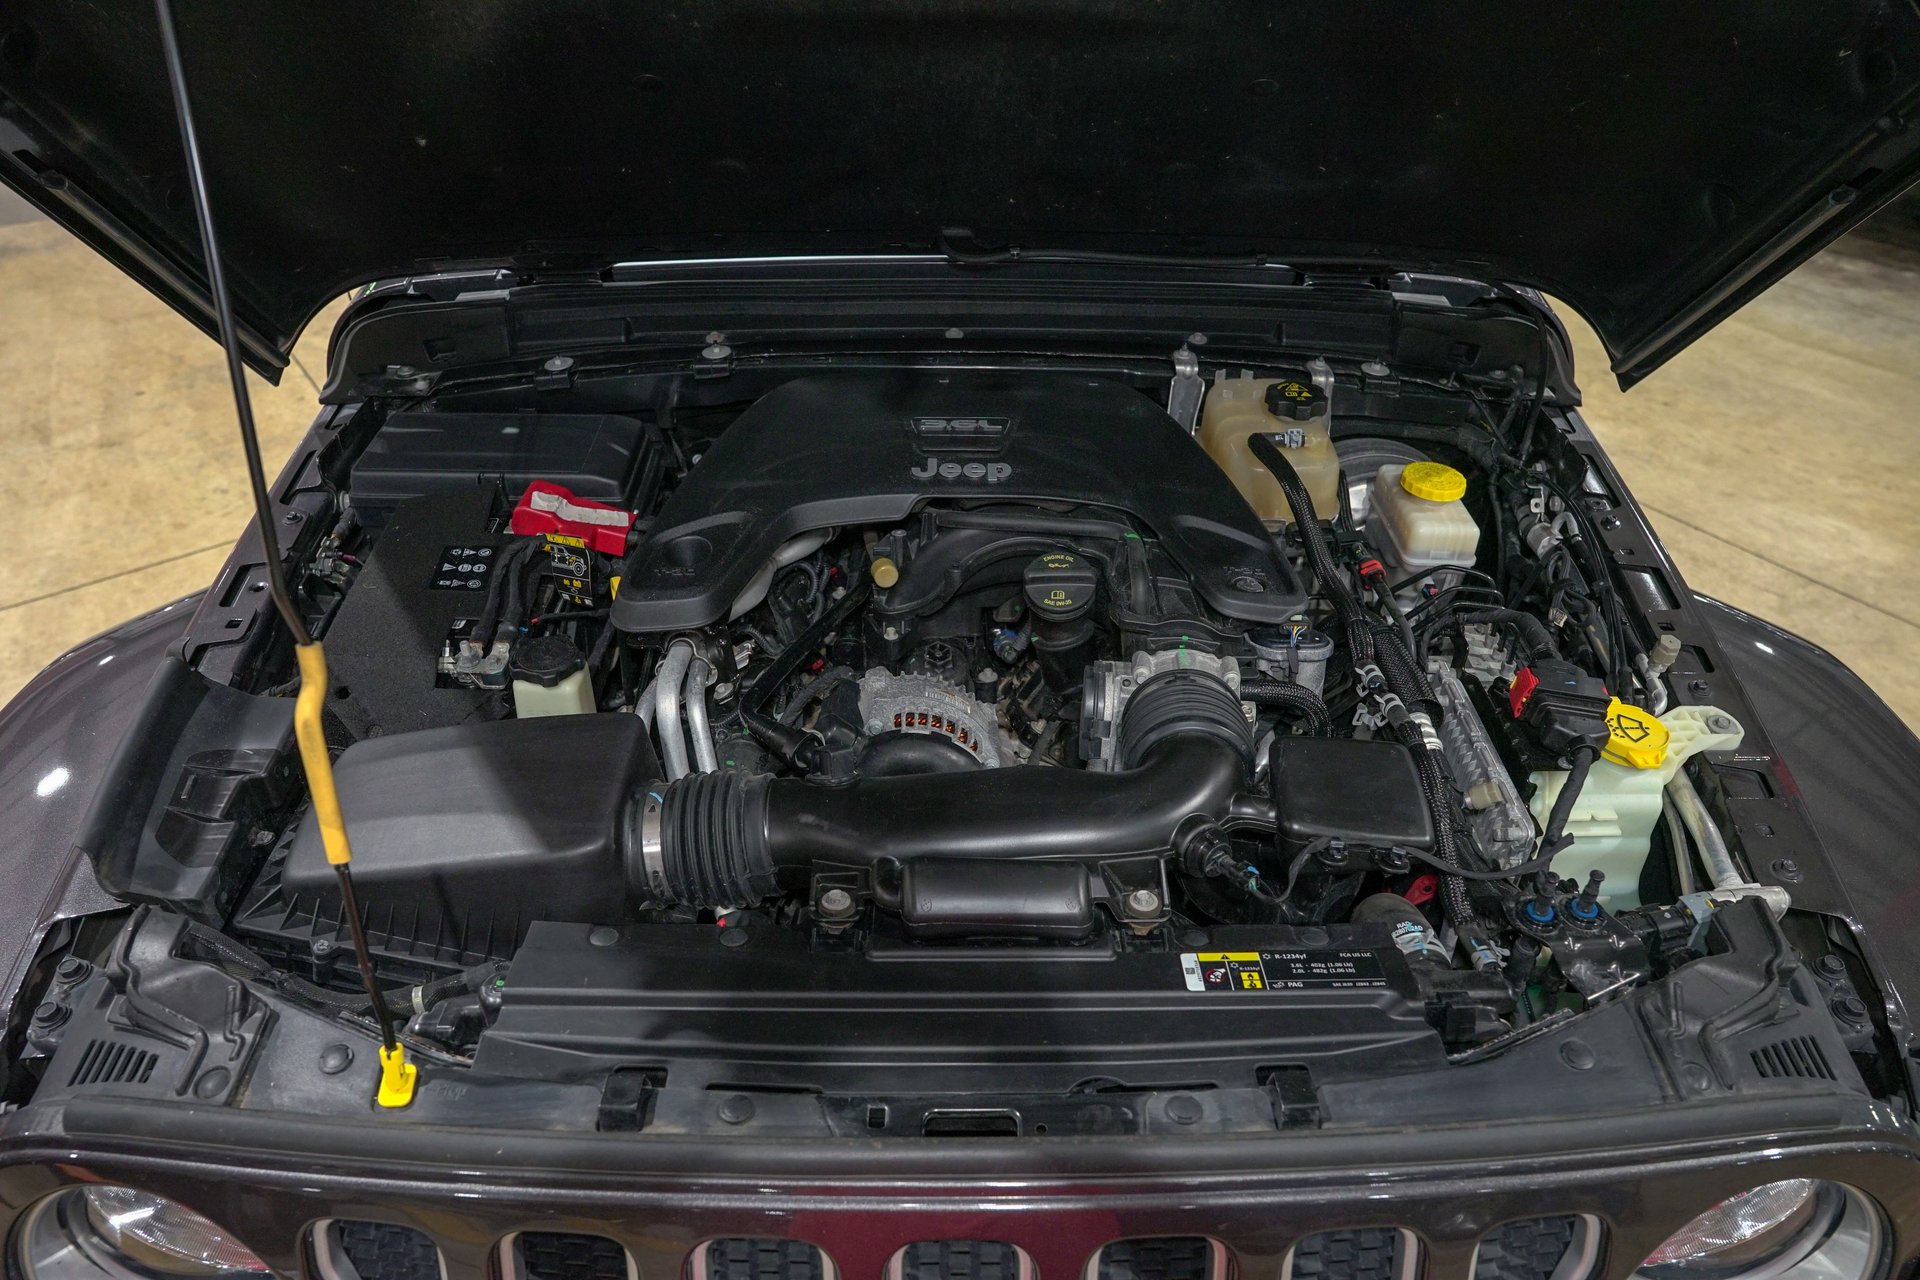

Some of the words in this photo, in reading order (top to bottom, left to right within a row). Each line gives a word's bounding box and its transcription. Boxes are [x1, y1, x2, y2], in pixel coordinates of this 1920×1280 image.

[919, 419, 1003, 432] 3.6L
[911, 457, 1013, 482] Jeep
[1043, 554, 1064, 562] ENGINE
[1065, 555, 1074, 563] OIL
[1043, 598, 1055, 606] SAE
